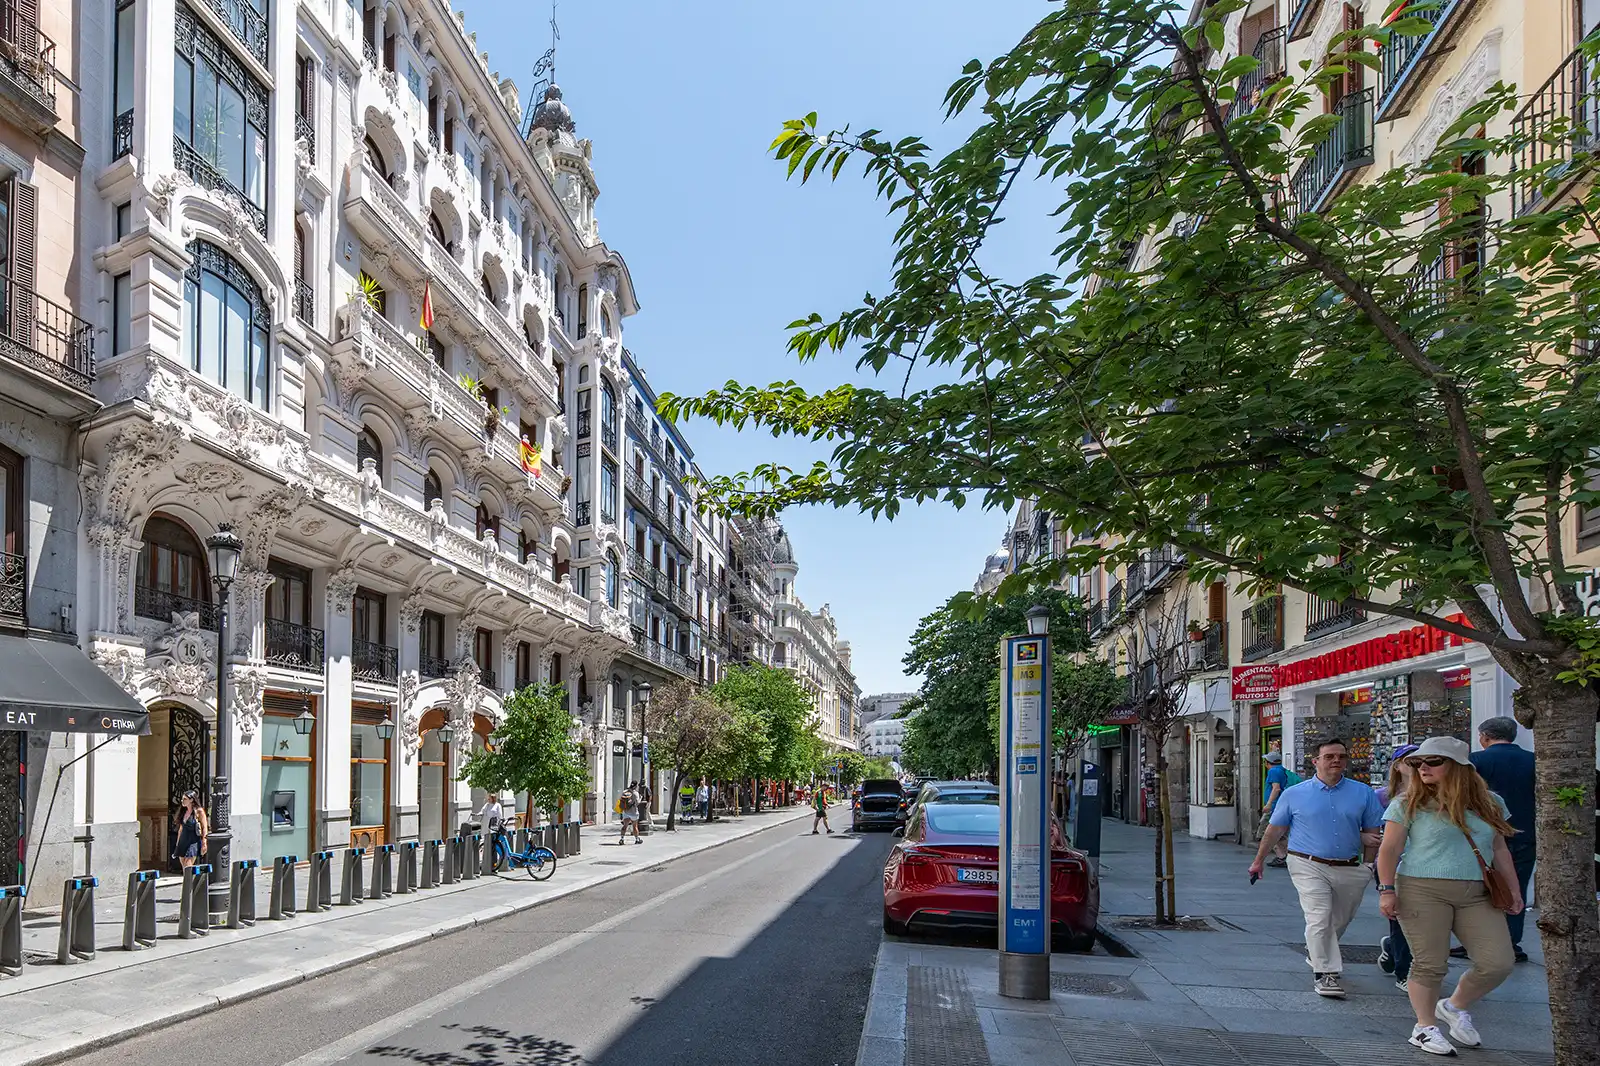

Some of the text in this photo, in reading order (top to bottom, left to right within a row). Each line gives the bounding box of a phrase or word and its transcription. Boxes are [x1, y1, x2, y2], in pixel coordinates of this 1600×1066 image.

[184, 643, 196, 657] 16
[1305, 633, 1398, 683] SOUVENIRS
[1020, 670, 1035, 680] M3
[6, 711, 37, 725] EAT
[1083, 763, 1094, 774] P
[964, 870, 993, 881] 2985
[1013, 918, 1037, 927] EMT
